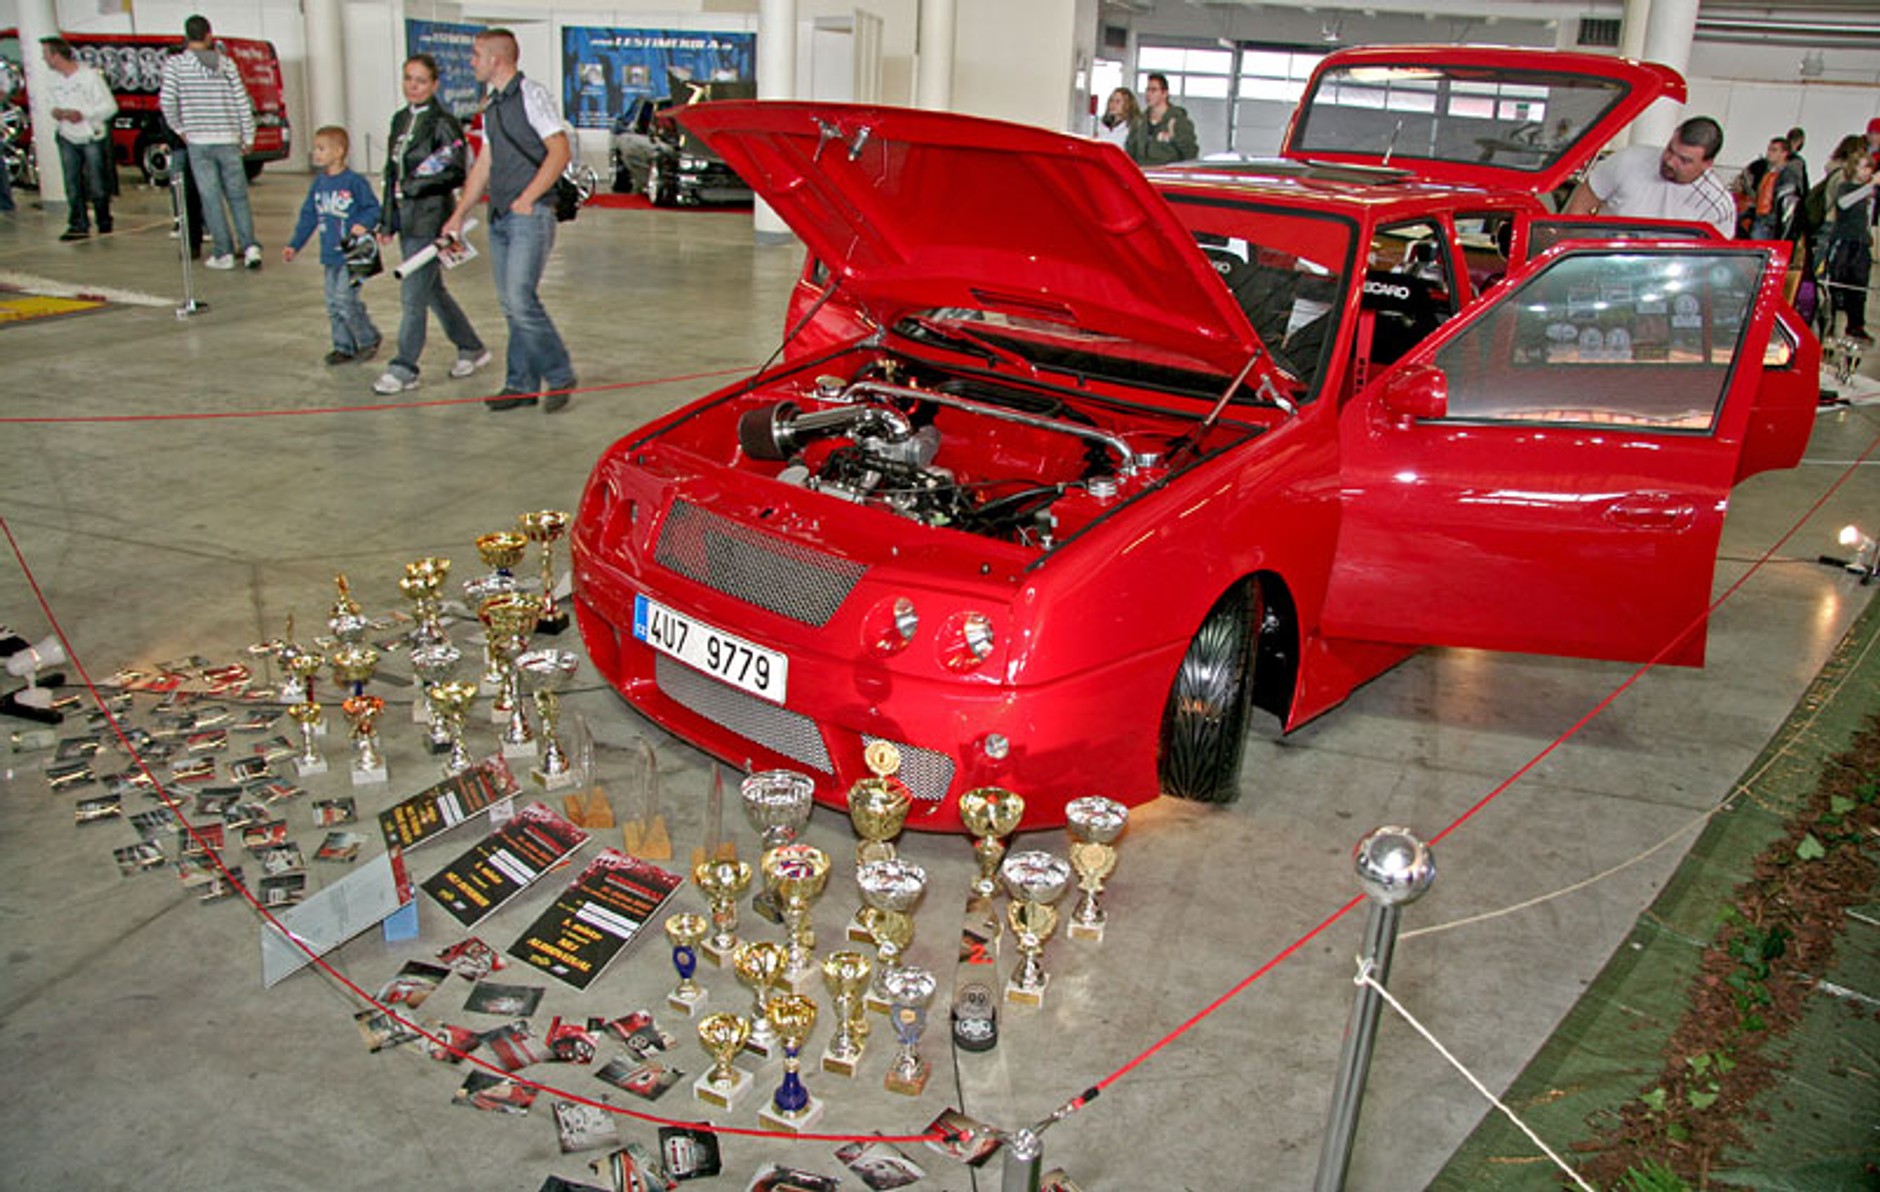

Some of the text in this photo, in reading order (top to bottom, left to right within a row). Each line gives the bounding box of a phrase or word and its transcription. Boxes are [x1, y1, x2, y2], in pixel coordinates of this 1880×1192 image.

[1363, 281, 1410, 299] ECARO
[651, 610, 770, 690] 4U7 9779
